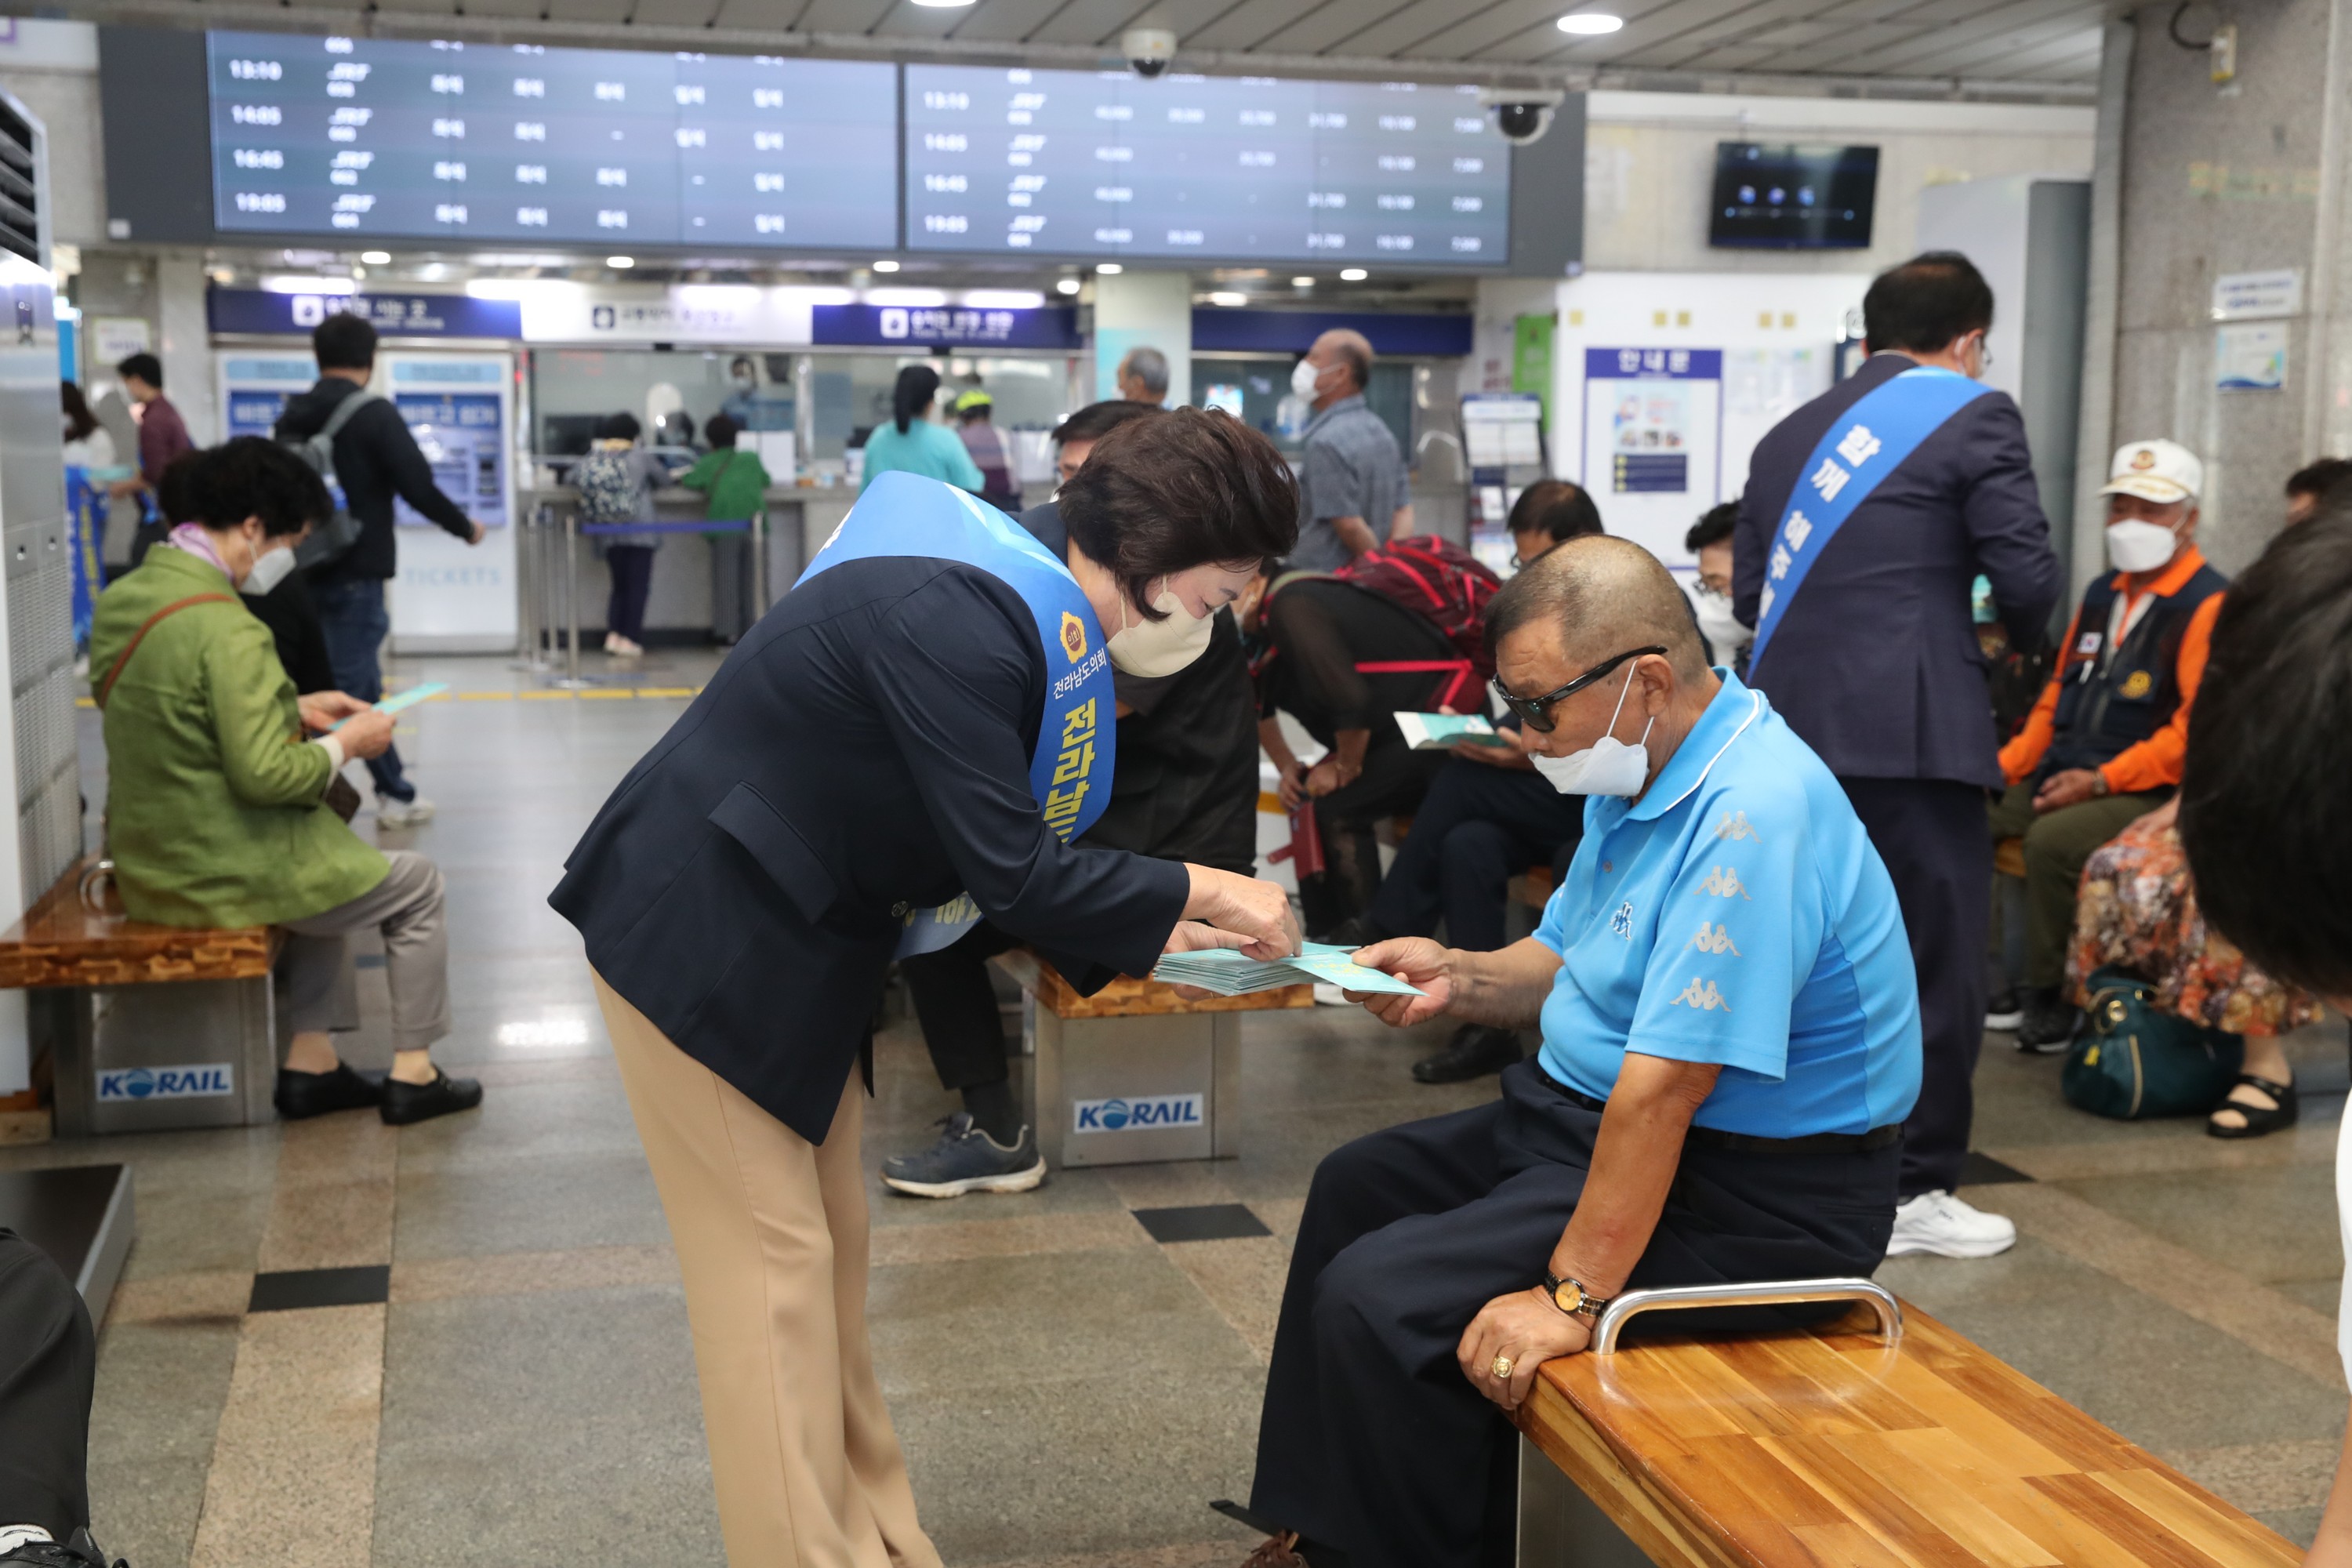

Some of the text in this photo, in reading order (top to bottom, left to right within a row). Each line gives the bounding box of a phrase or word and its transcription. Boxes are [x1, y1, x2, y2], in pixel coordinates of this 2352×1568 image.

[1809, 423, 1882, 503] 함께
[1053, 647, 1108, 700] 전라남도의회
[100, 1067, 229, 1099] KORAIL
[1078, 1098, 1199, 1130] KORAIL
